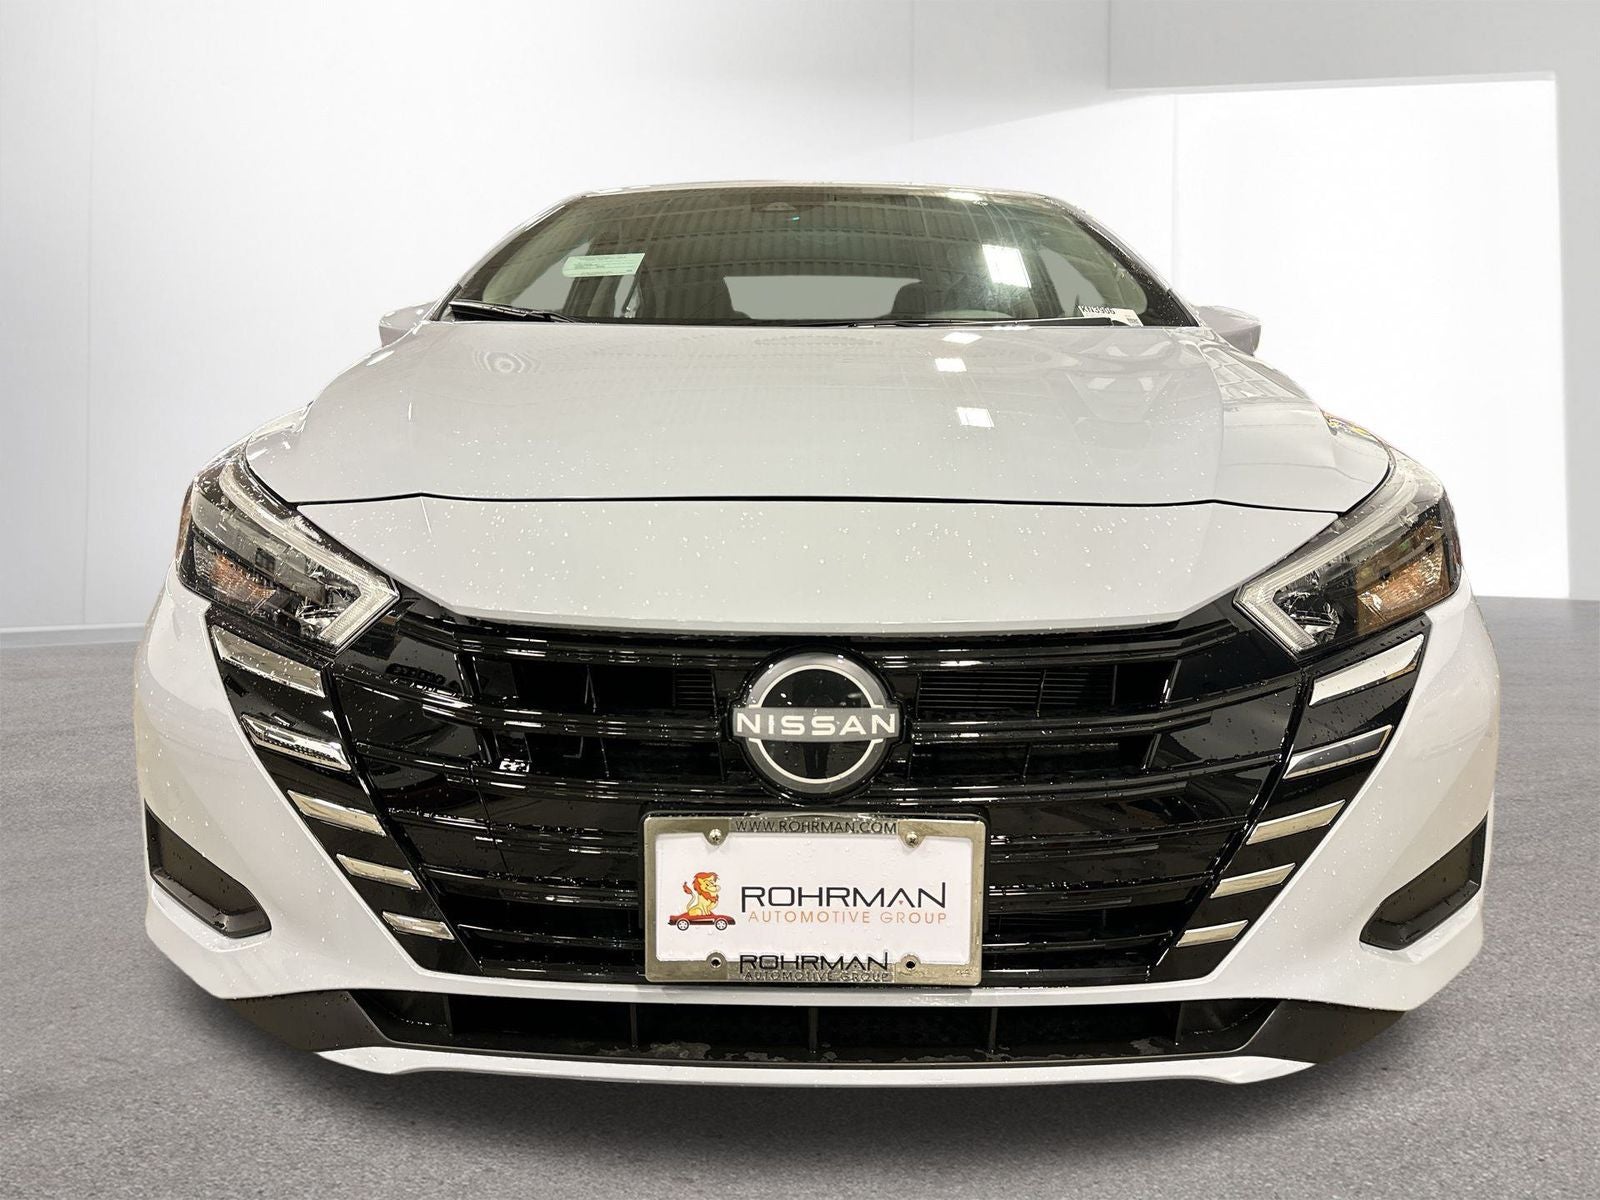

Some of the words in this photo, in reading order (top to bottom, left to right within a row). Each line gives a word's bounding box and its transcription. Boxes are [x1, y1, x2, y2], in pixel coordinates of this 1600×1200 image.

[736, 713, 896, 736] NISSAN
[735, 820, 897, 833] WWW.ROHRMAN.COM
[741, 882, 946, 913] ROHRMAN
[748, 910, 871, 924] AUTOMOTIVE
[880, 911, 947, 925] GROUP
[739, 952, 888, 974] ROHRMAN
[744, 971, 833, 982] AUTOMOTIVE
[841, 971, 890, 983] GROUP
